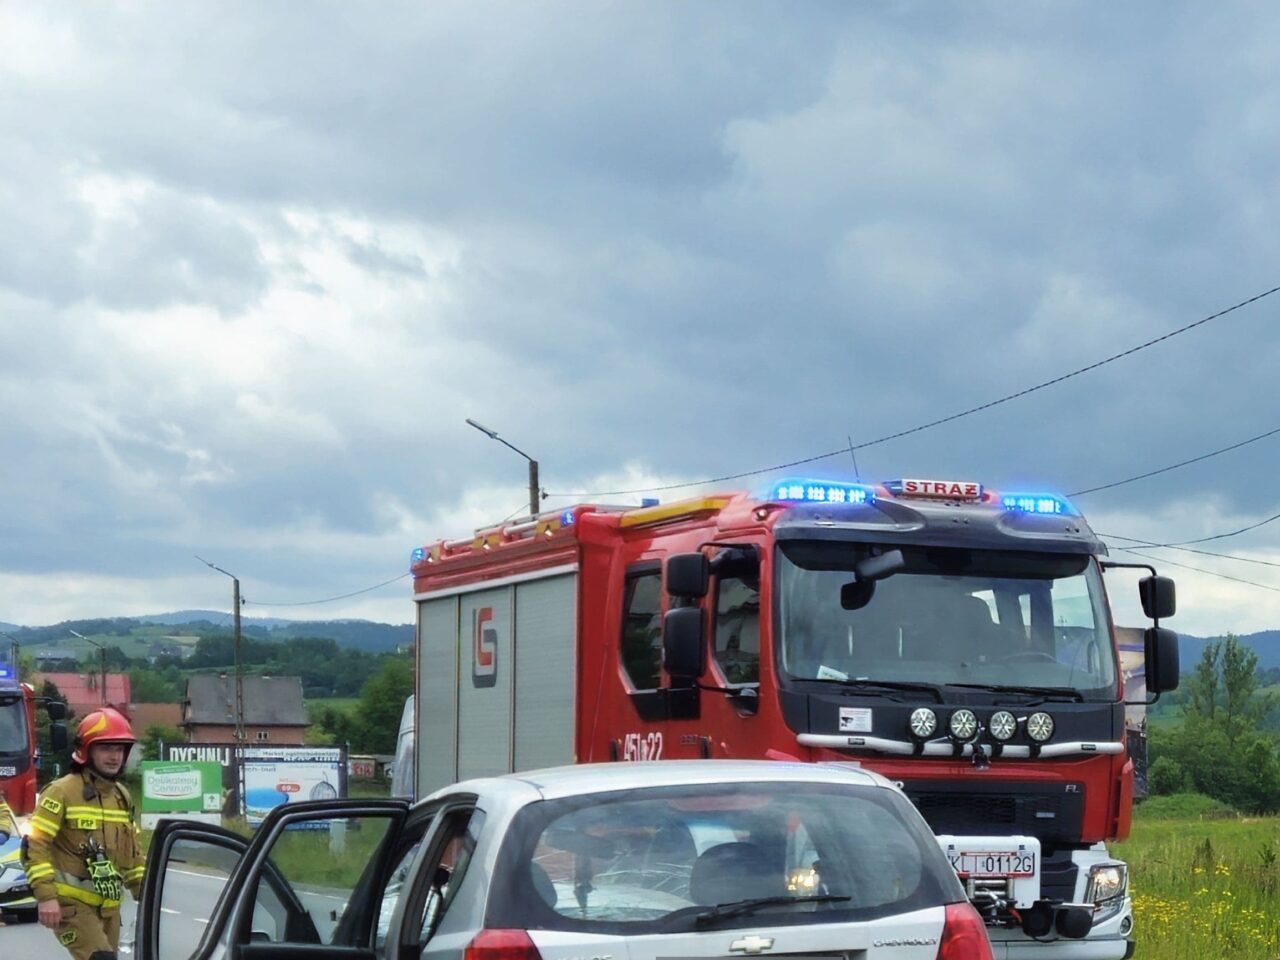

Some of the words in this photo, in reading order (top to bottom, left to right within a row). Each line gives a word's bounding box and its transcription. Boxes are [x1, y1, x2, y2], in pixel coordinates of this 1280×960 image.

[152, 784, 193, 793] Centrum
[43, 799, 59, 811] PSP
[80, 818, 95, 828] PSP
